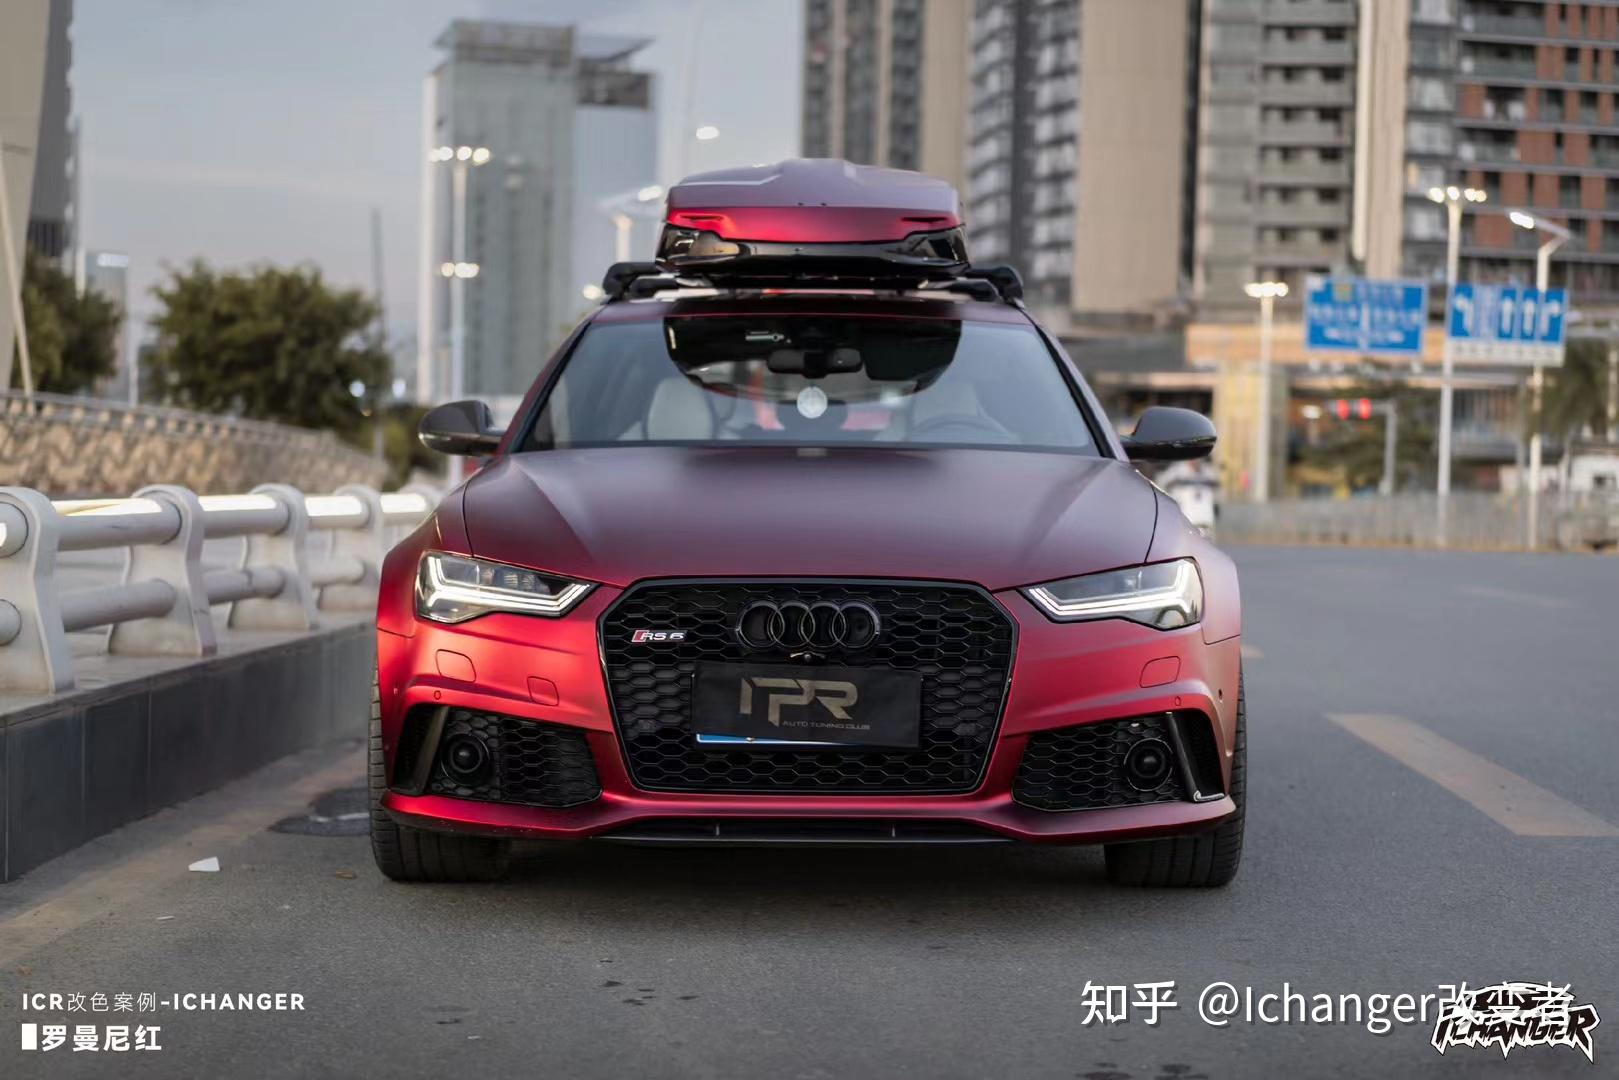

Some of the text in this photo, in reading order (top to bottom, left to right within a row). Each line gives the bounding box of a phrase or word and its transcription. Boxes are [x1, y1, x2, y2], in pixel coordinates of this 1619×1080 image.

[782, 720, 871, 731] AUTO TUNING CLUB
